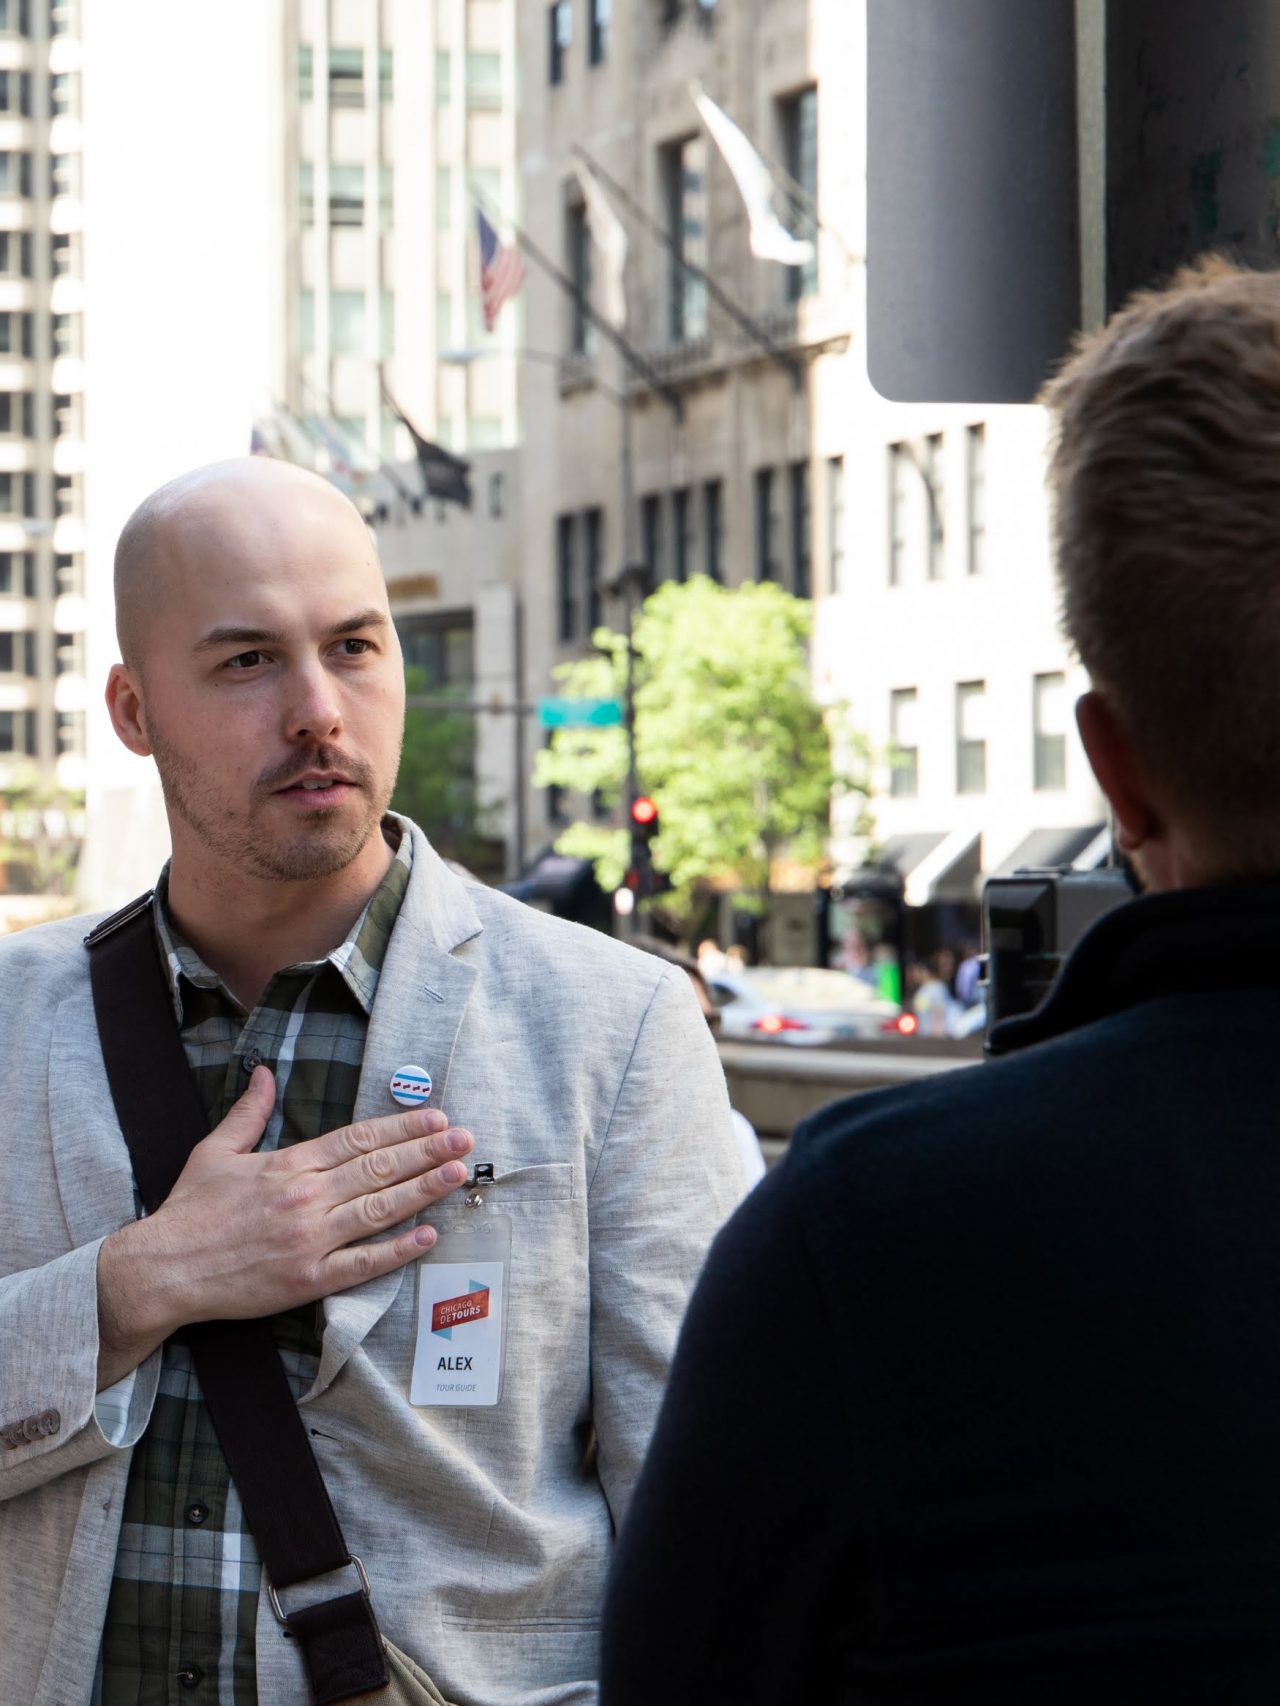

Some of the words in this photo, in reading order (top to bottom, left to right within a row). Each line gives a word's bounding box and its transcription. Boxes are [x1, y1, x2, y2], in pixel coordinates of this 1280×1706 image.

[440, 1300, 473, 1315] CHICAGO
[440, 1305, 481, 1325] DETOURS
[437, 1356, 473, 1371] ALEX
[436, 1383, 454, 1393] TOUR
[455, 1383, 477, 1393] GUIDE
